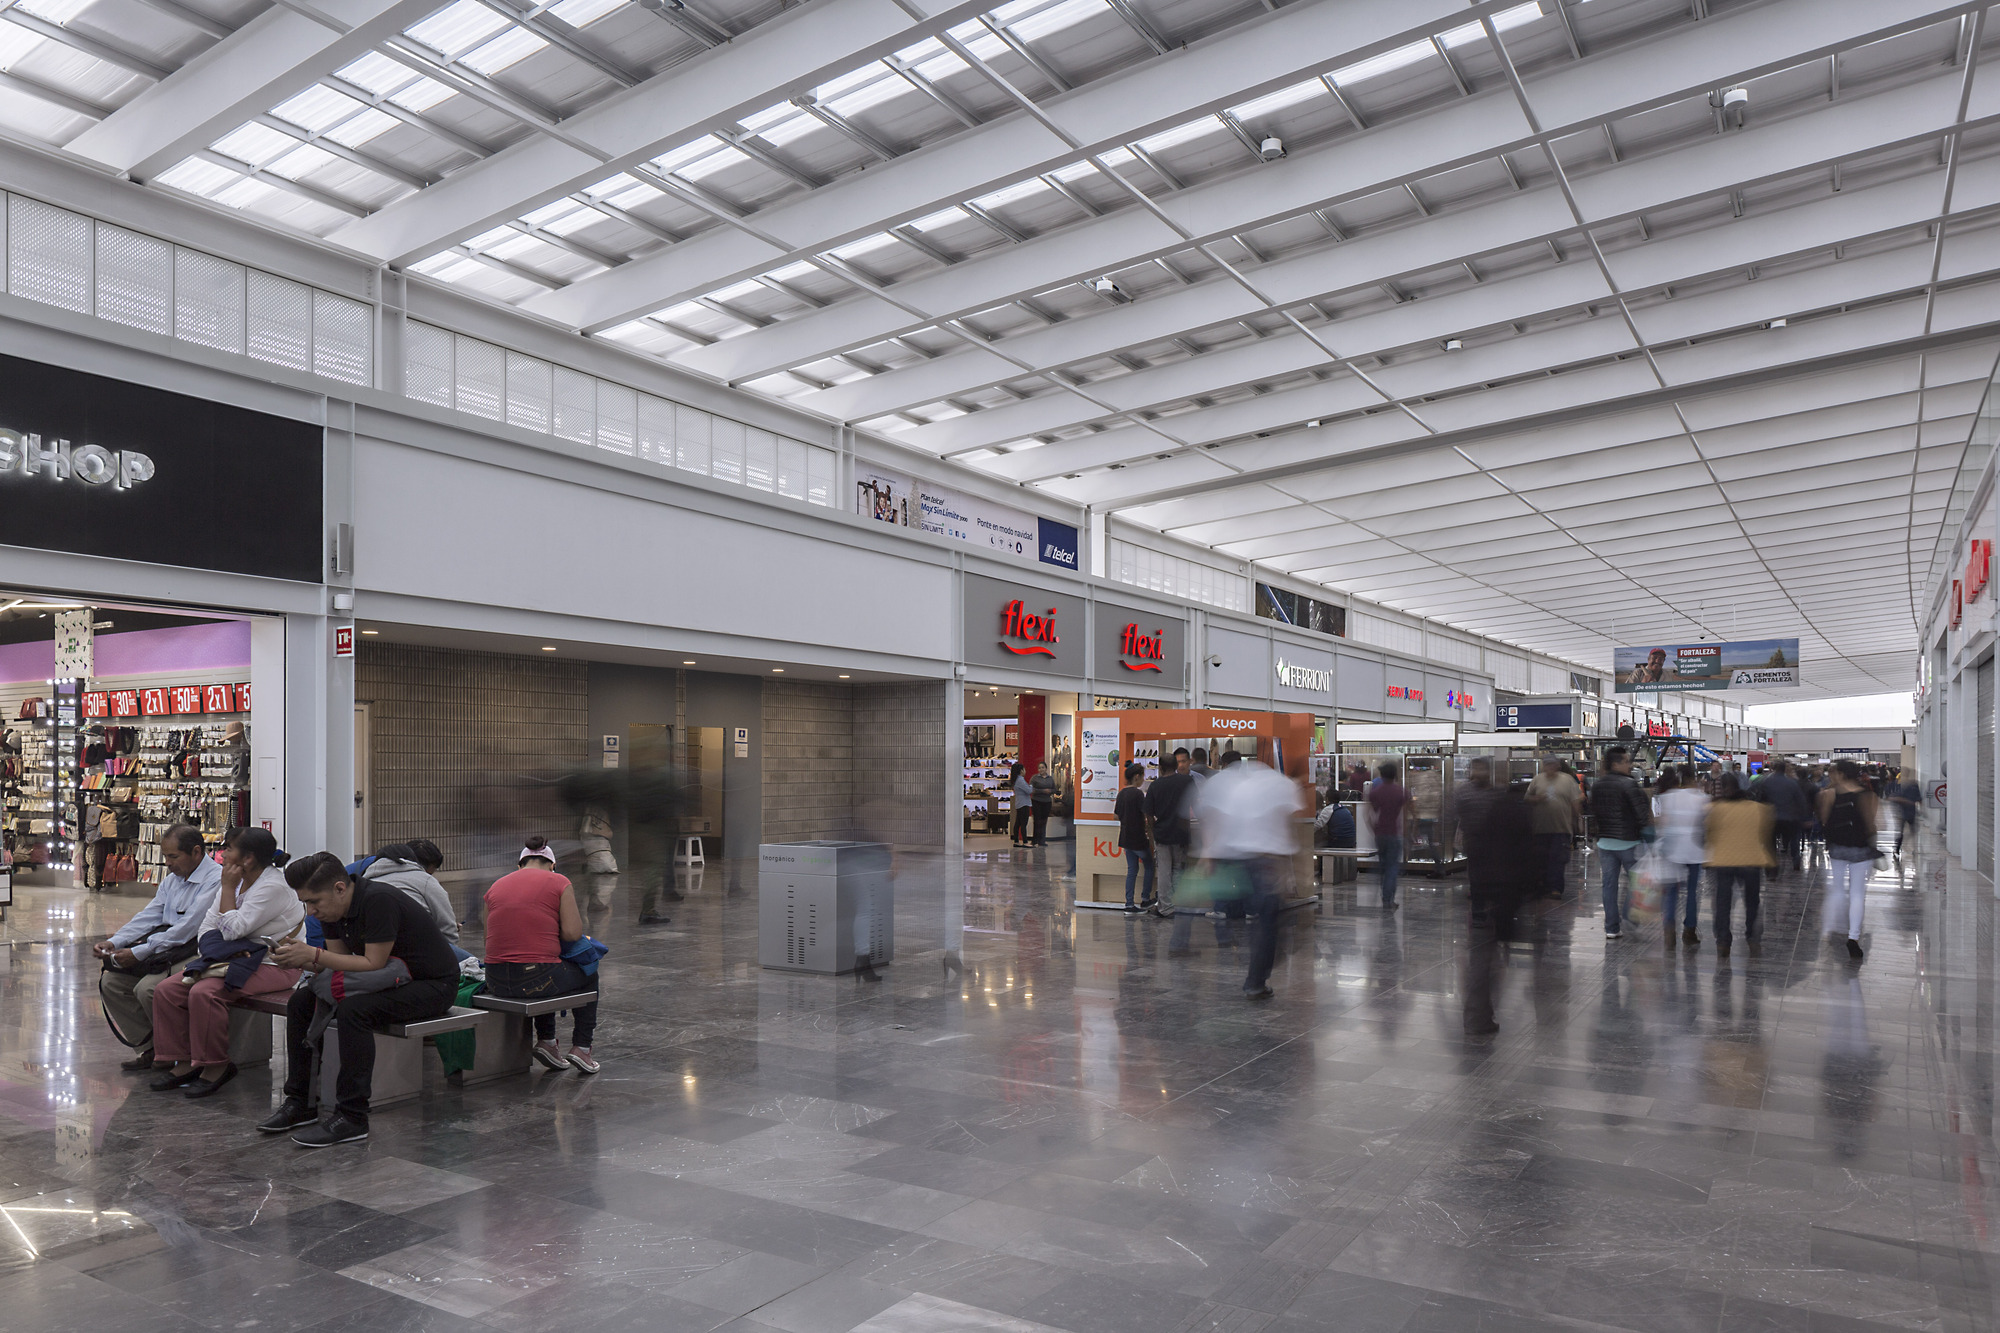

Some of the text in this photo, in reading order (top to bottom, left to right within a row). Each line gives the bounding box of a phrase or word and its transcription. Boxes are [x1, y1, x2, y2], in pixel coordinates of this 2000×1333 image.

[920, 493, 931, 503] Plan
[977, 518, 1033, 541] Ponte en modo navidad
[1052, 546, 1075, 564] telcel
[1680, 648, 1716, 656] FORTALEZA:
[1290, 665, 1330, 692] FERRIONI
[1753, 676, 1792, 684] FORTALEZA
[145, 690, 164, 714] 2x1
[207, 686, 228, 712] 2x1
[1212, 716, 1257, 731] kuepa
